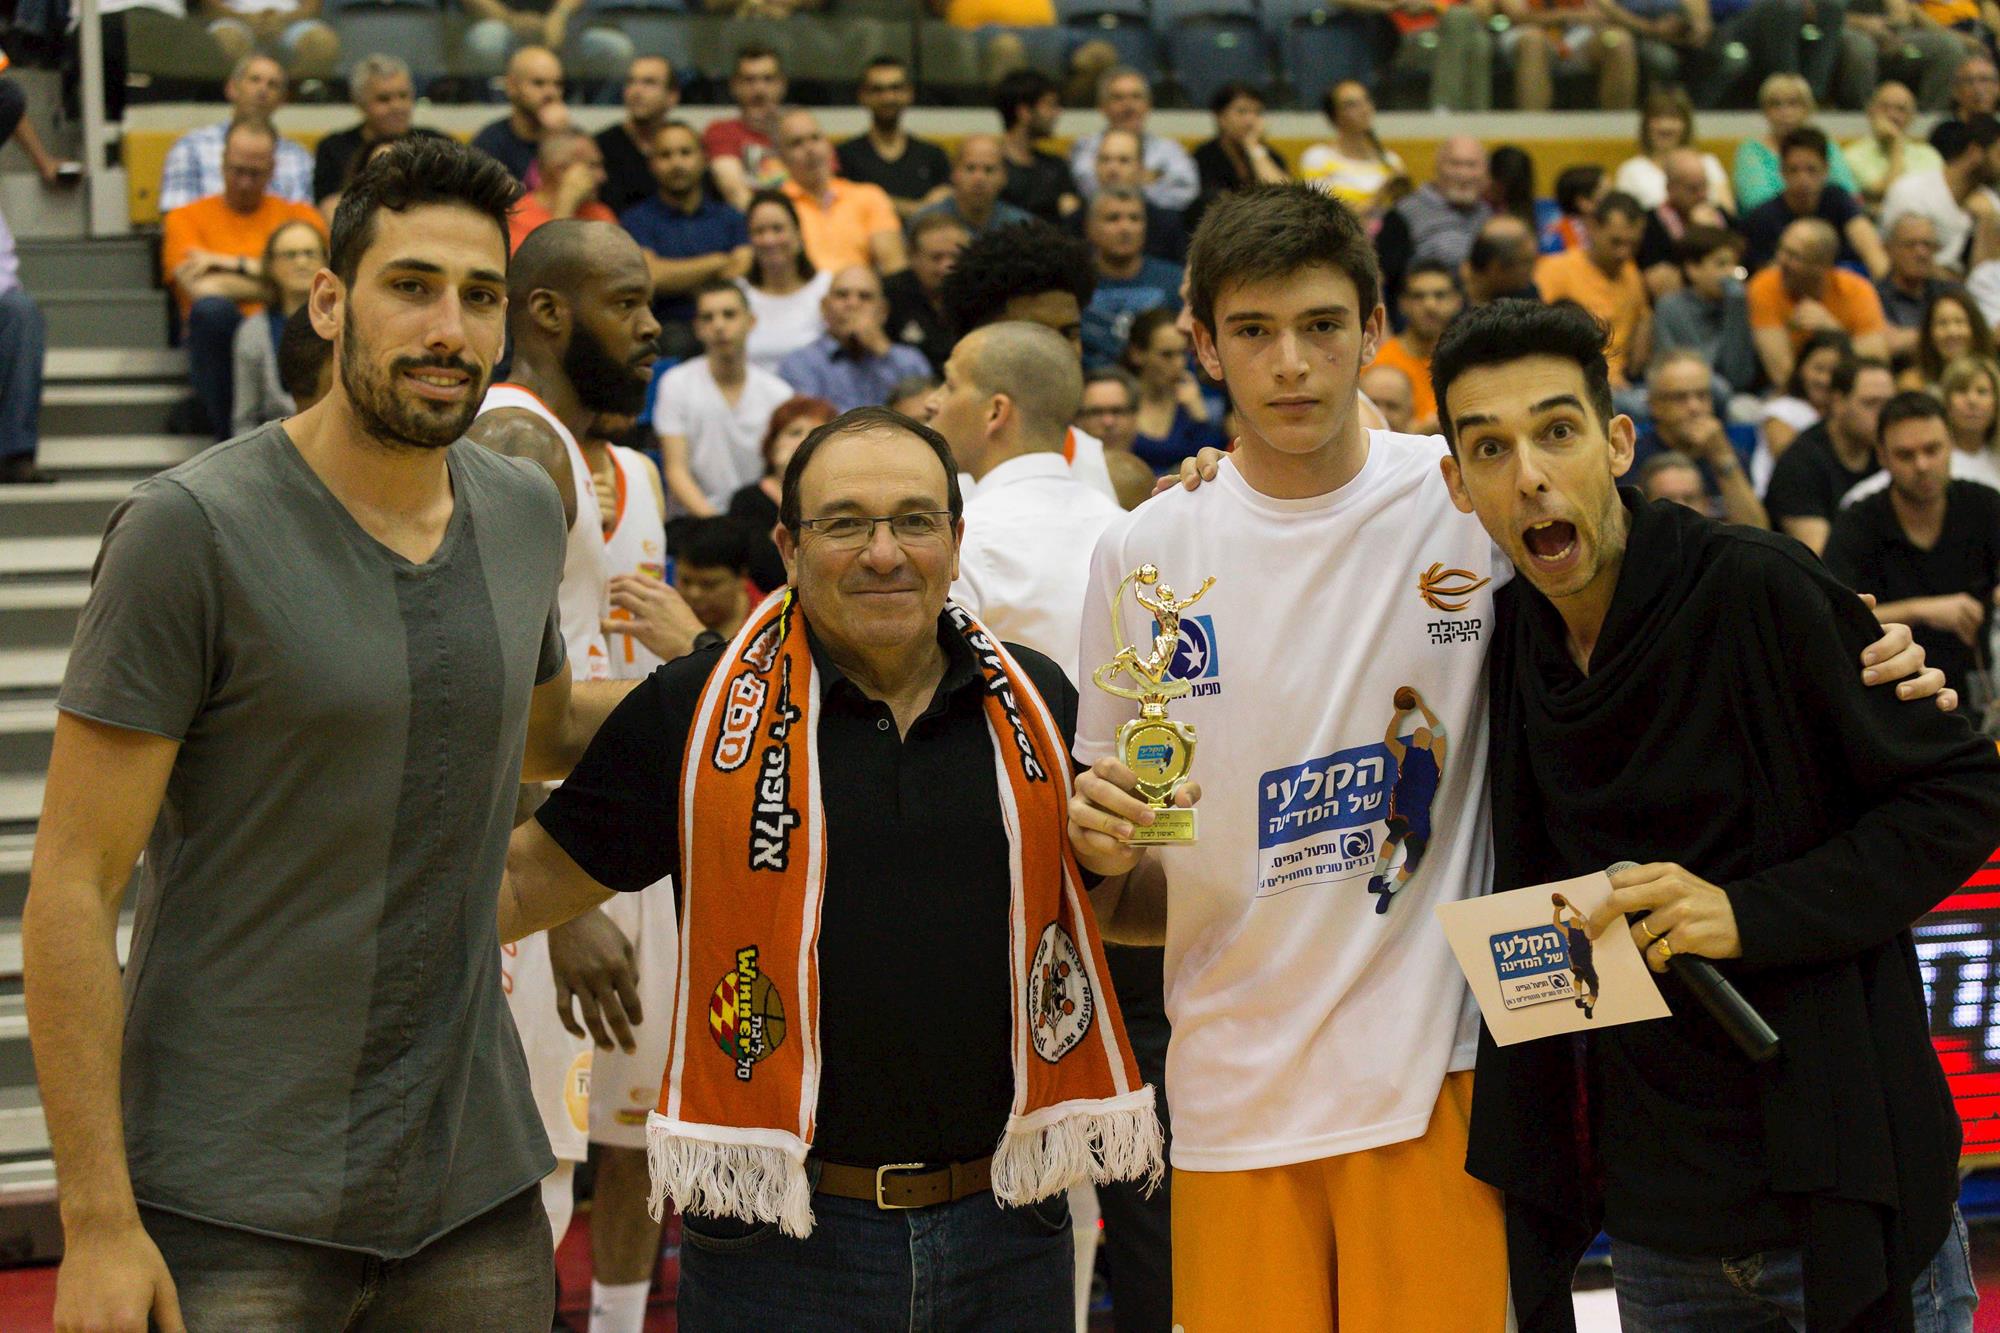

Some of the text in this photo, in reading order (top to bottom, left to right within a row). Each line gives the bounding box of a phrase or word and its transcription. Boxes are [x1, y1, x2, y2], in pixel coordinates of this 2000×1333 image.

[1427, 619, 1482, 633] מנהלת
[1431, 630, 1479, 644] הליגה
[1266, 756, 1385, 812] הקלעי
[752, 745, 796, 869] אלופת
[1348, 790, 1383, 813] של
[1304, 843, 1337, 855] מפעל
[1315, 862, 1342, 874] טובים
[1345, 854, 1375, 870] דברים
[1268, 867, 1313, 888] מתחילים
[1494, 932, 1560, 960] הקלעי
[1500, 952, 1564, 972] של המדינה
[738, 948, 757, 1054] Winner
